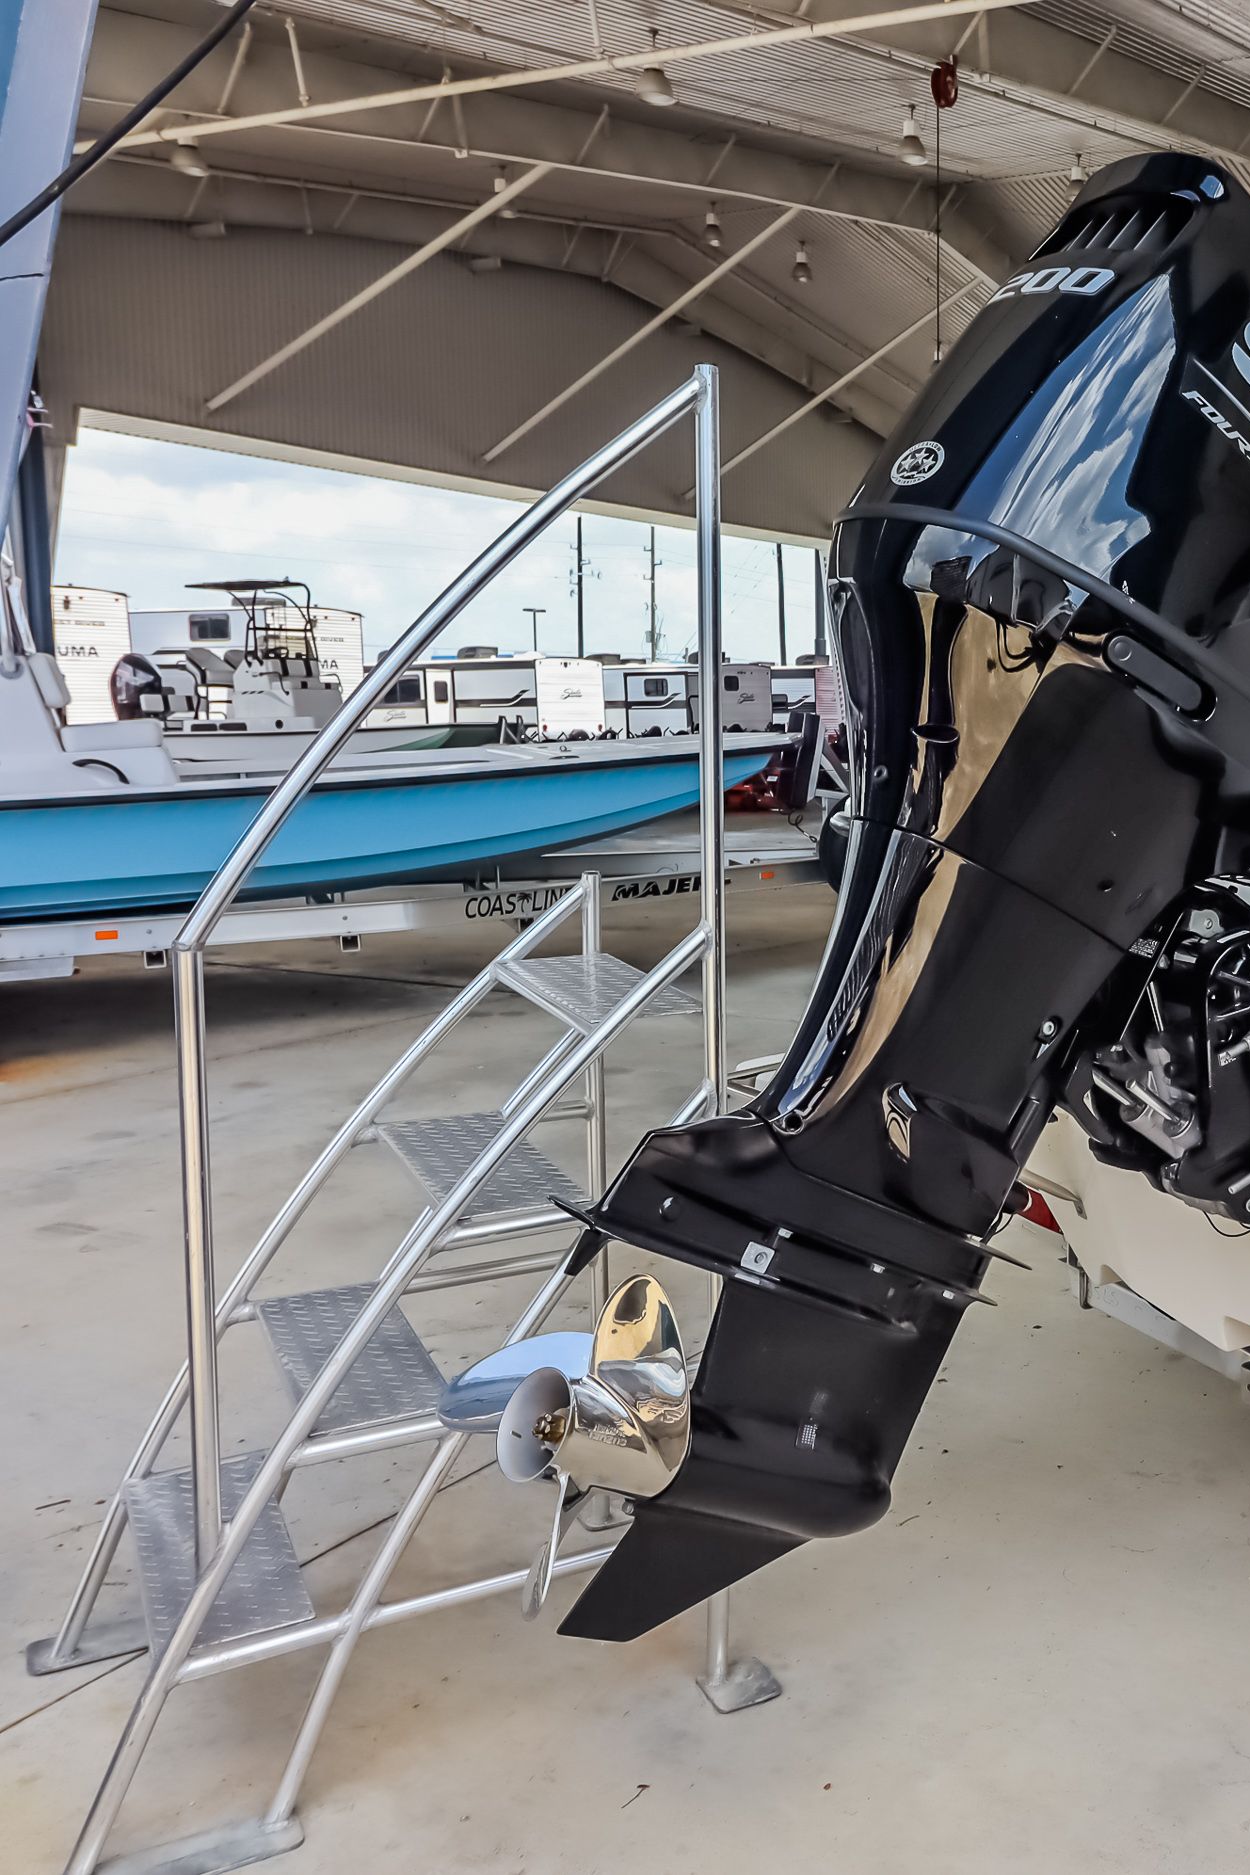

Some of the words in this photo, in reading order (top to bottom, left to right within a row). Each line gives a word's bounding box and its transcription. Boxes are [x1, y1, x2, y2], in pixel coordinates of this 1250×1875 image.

[986, 267, 1116, 305] 200
[57, 646, 101, 658] UMA
[464, 886, 574, 919] COASTLIN
